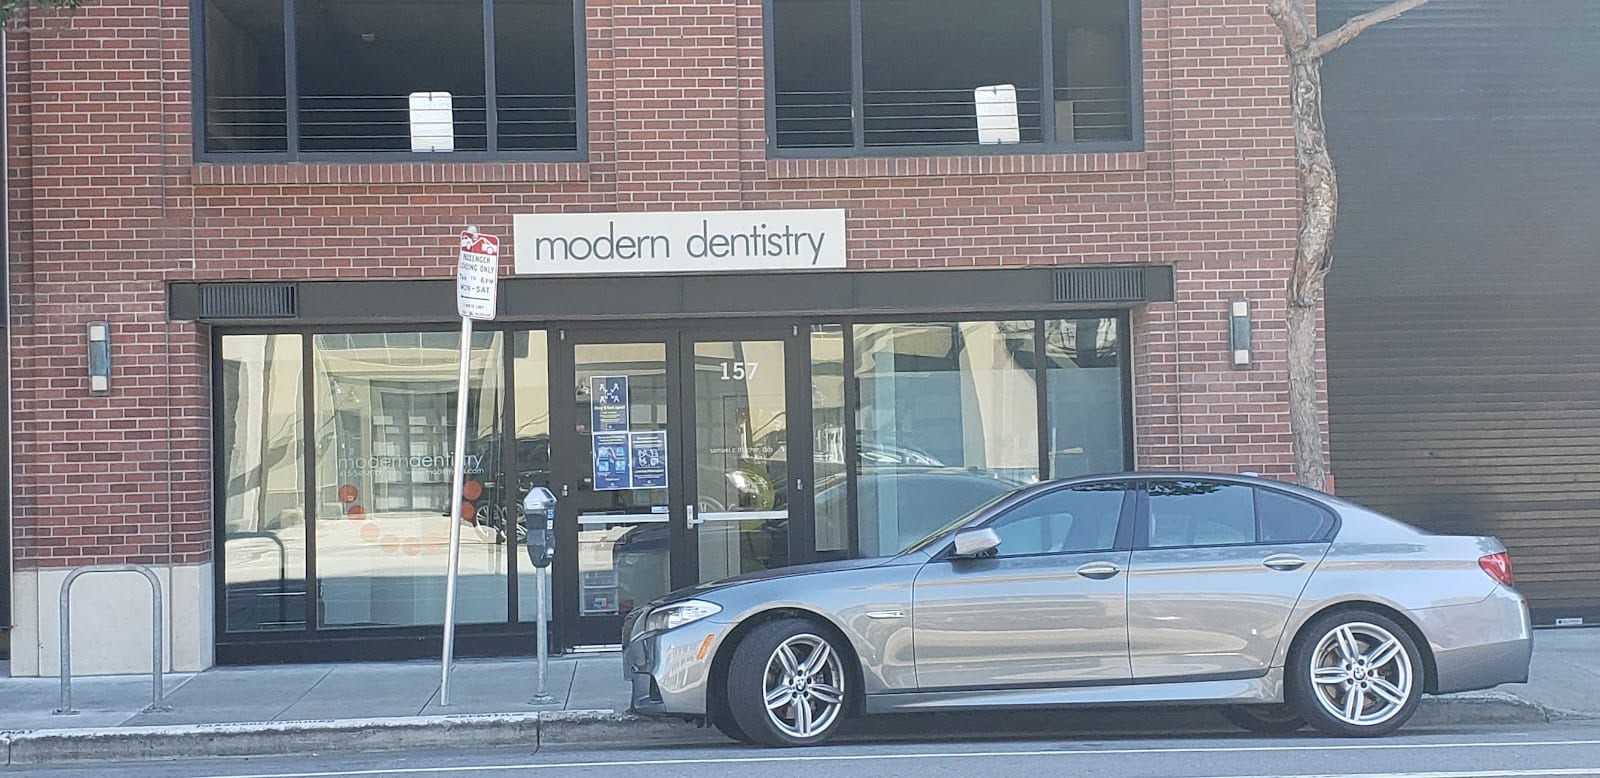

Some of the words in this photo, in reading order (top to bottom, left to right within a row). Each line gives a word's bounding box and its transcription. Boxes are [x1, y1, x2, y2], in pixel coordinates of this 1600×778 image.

[536, 221, 670, 260] modern
[686, 219, 825, 265] dentistry
[480, 265, 495, 274] ONLY
[720, 362, 759, 380] 157
[338, 452, 483, 470] moderndentitry
